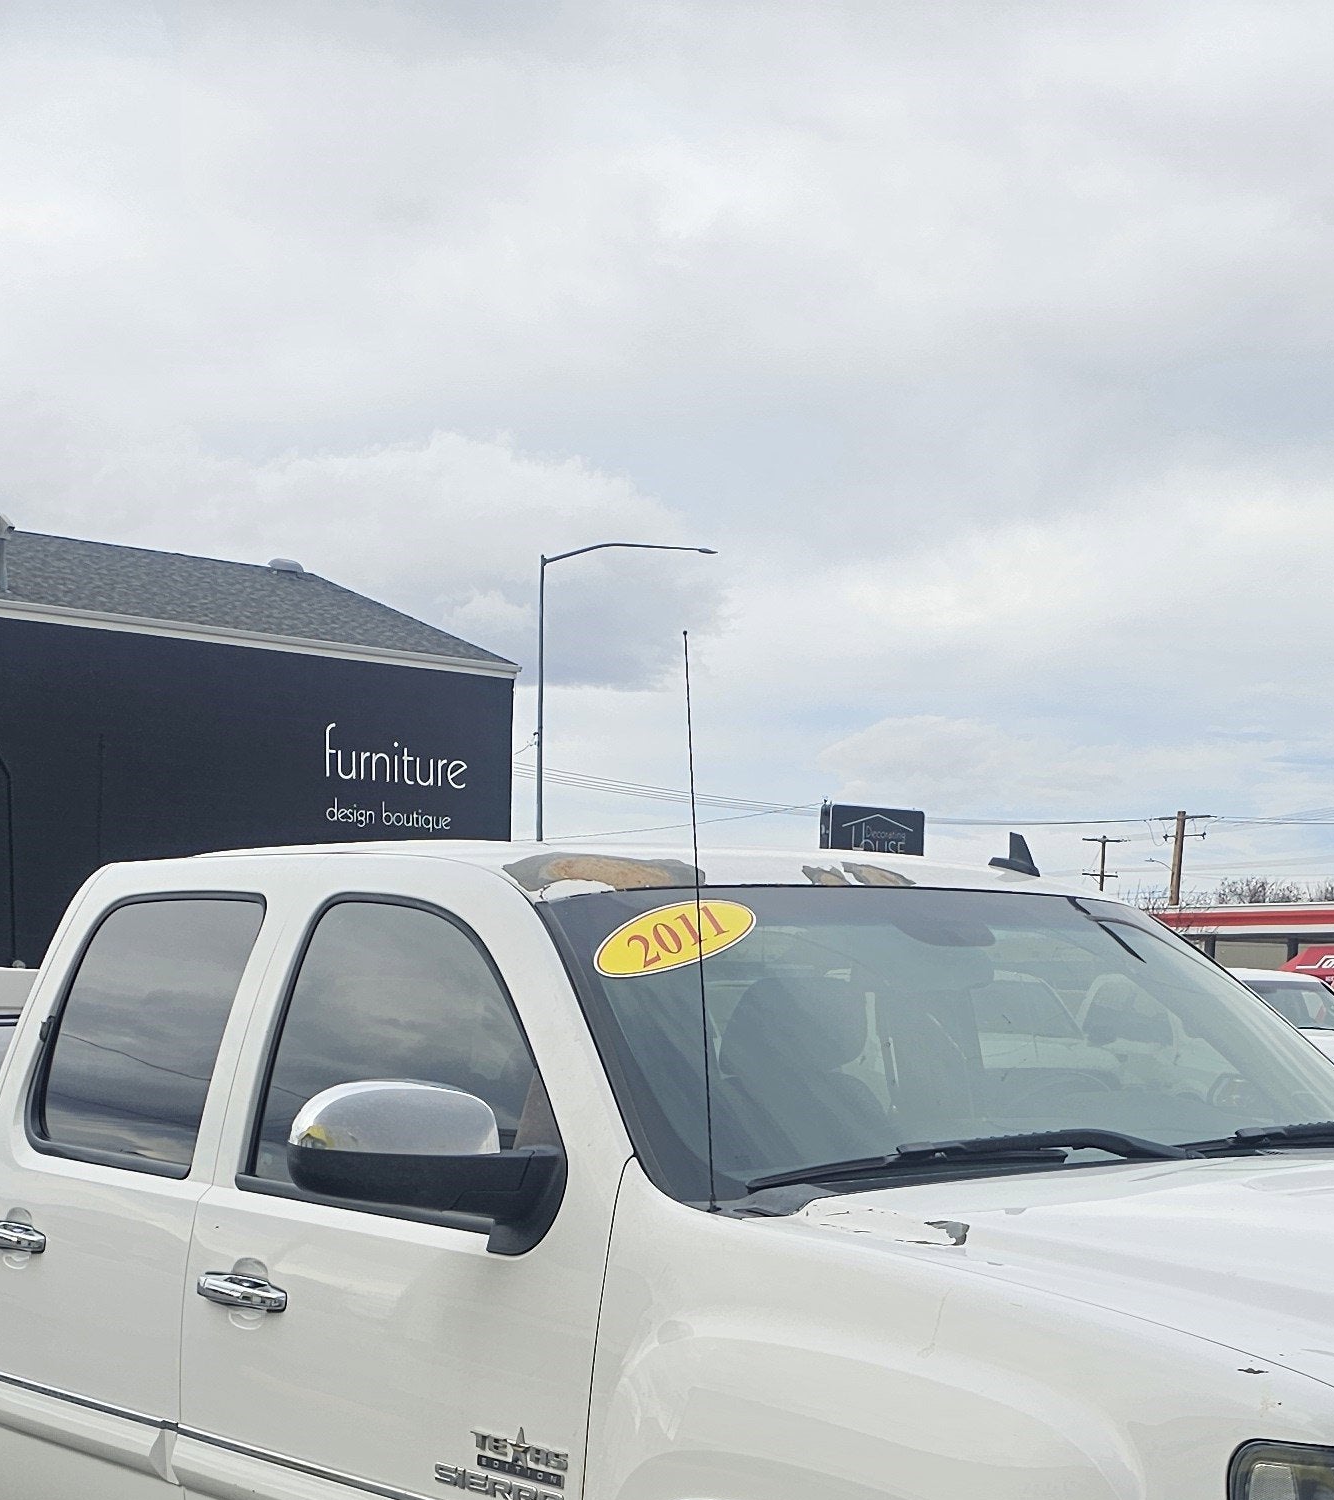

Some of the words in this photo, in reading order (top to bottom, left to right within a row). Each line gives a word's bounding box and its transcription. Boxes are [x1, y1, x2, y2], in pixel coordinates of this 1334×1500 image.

[324, 722, 468, 789] furniture
[326, 797, 375, 828] design
[382, 801, 452, 833] boutique
[627, 905, 730, 968] 2011
[481, 1456, 559, 1485] EDITION
